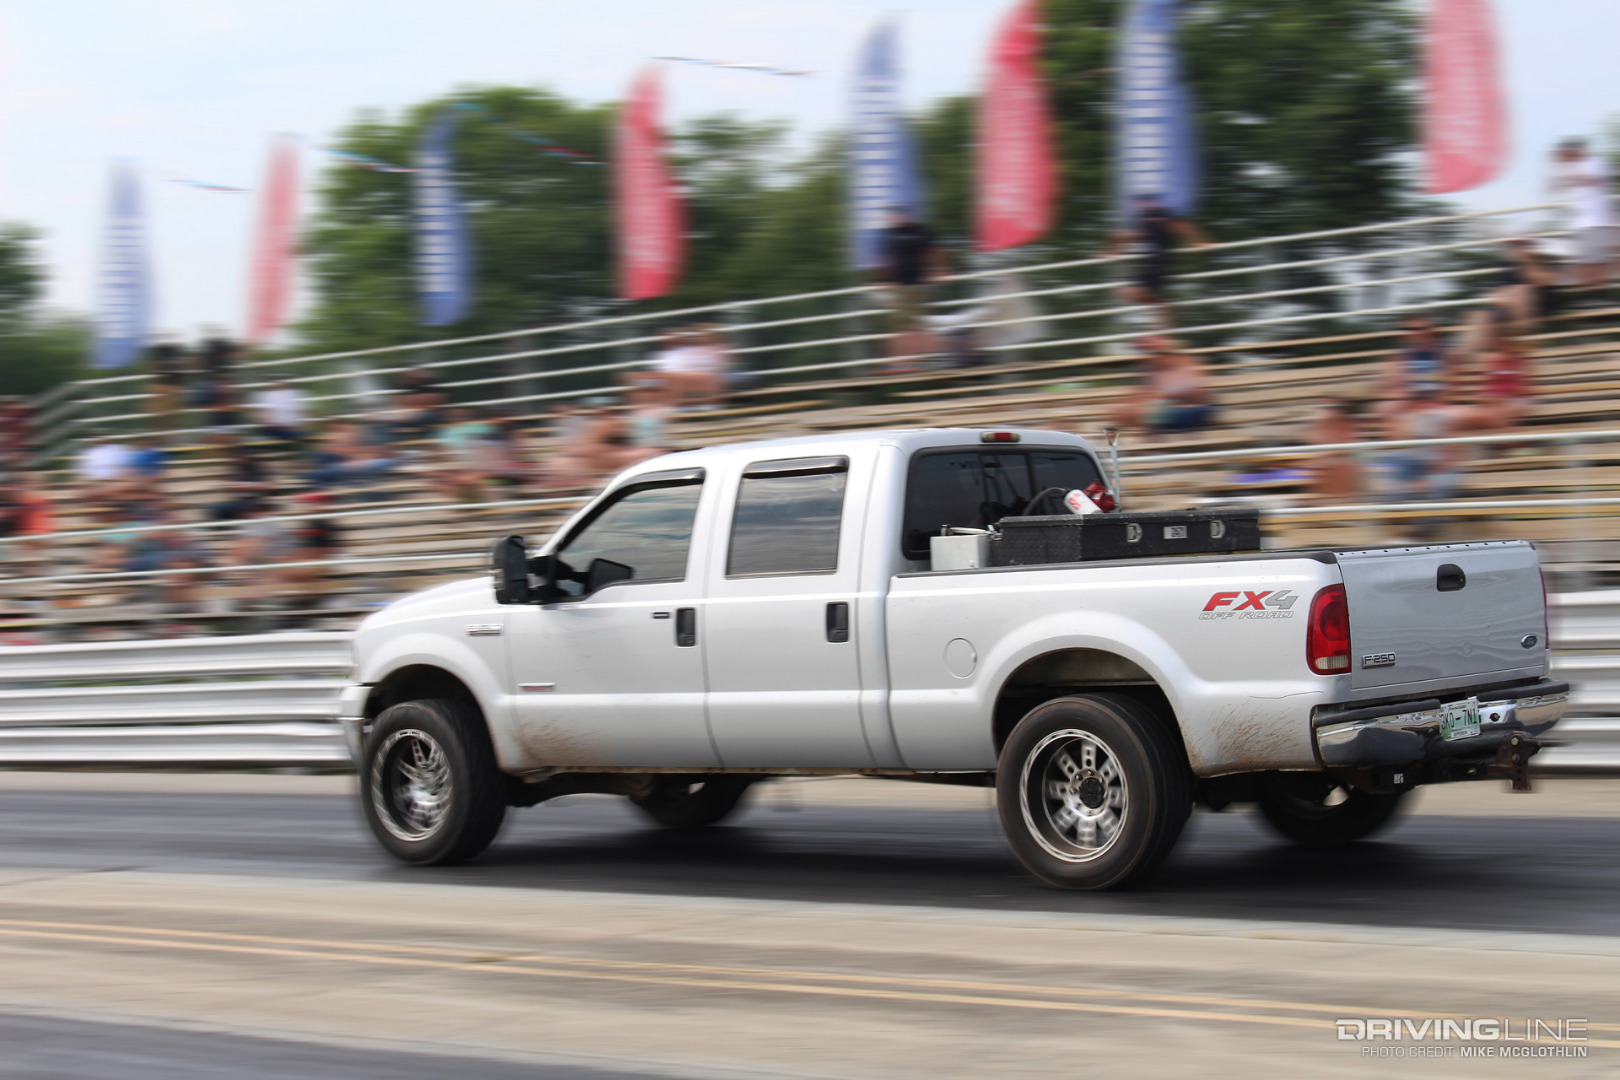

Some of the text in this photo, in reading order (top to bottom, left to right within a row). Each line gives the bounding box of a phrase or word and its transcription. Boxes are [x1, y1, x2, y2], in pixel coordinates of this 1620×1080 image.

[1202, 590, 1299, 611] FX4
[1199, 610, 1294, 620] OFF ROAD
